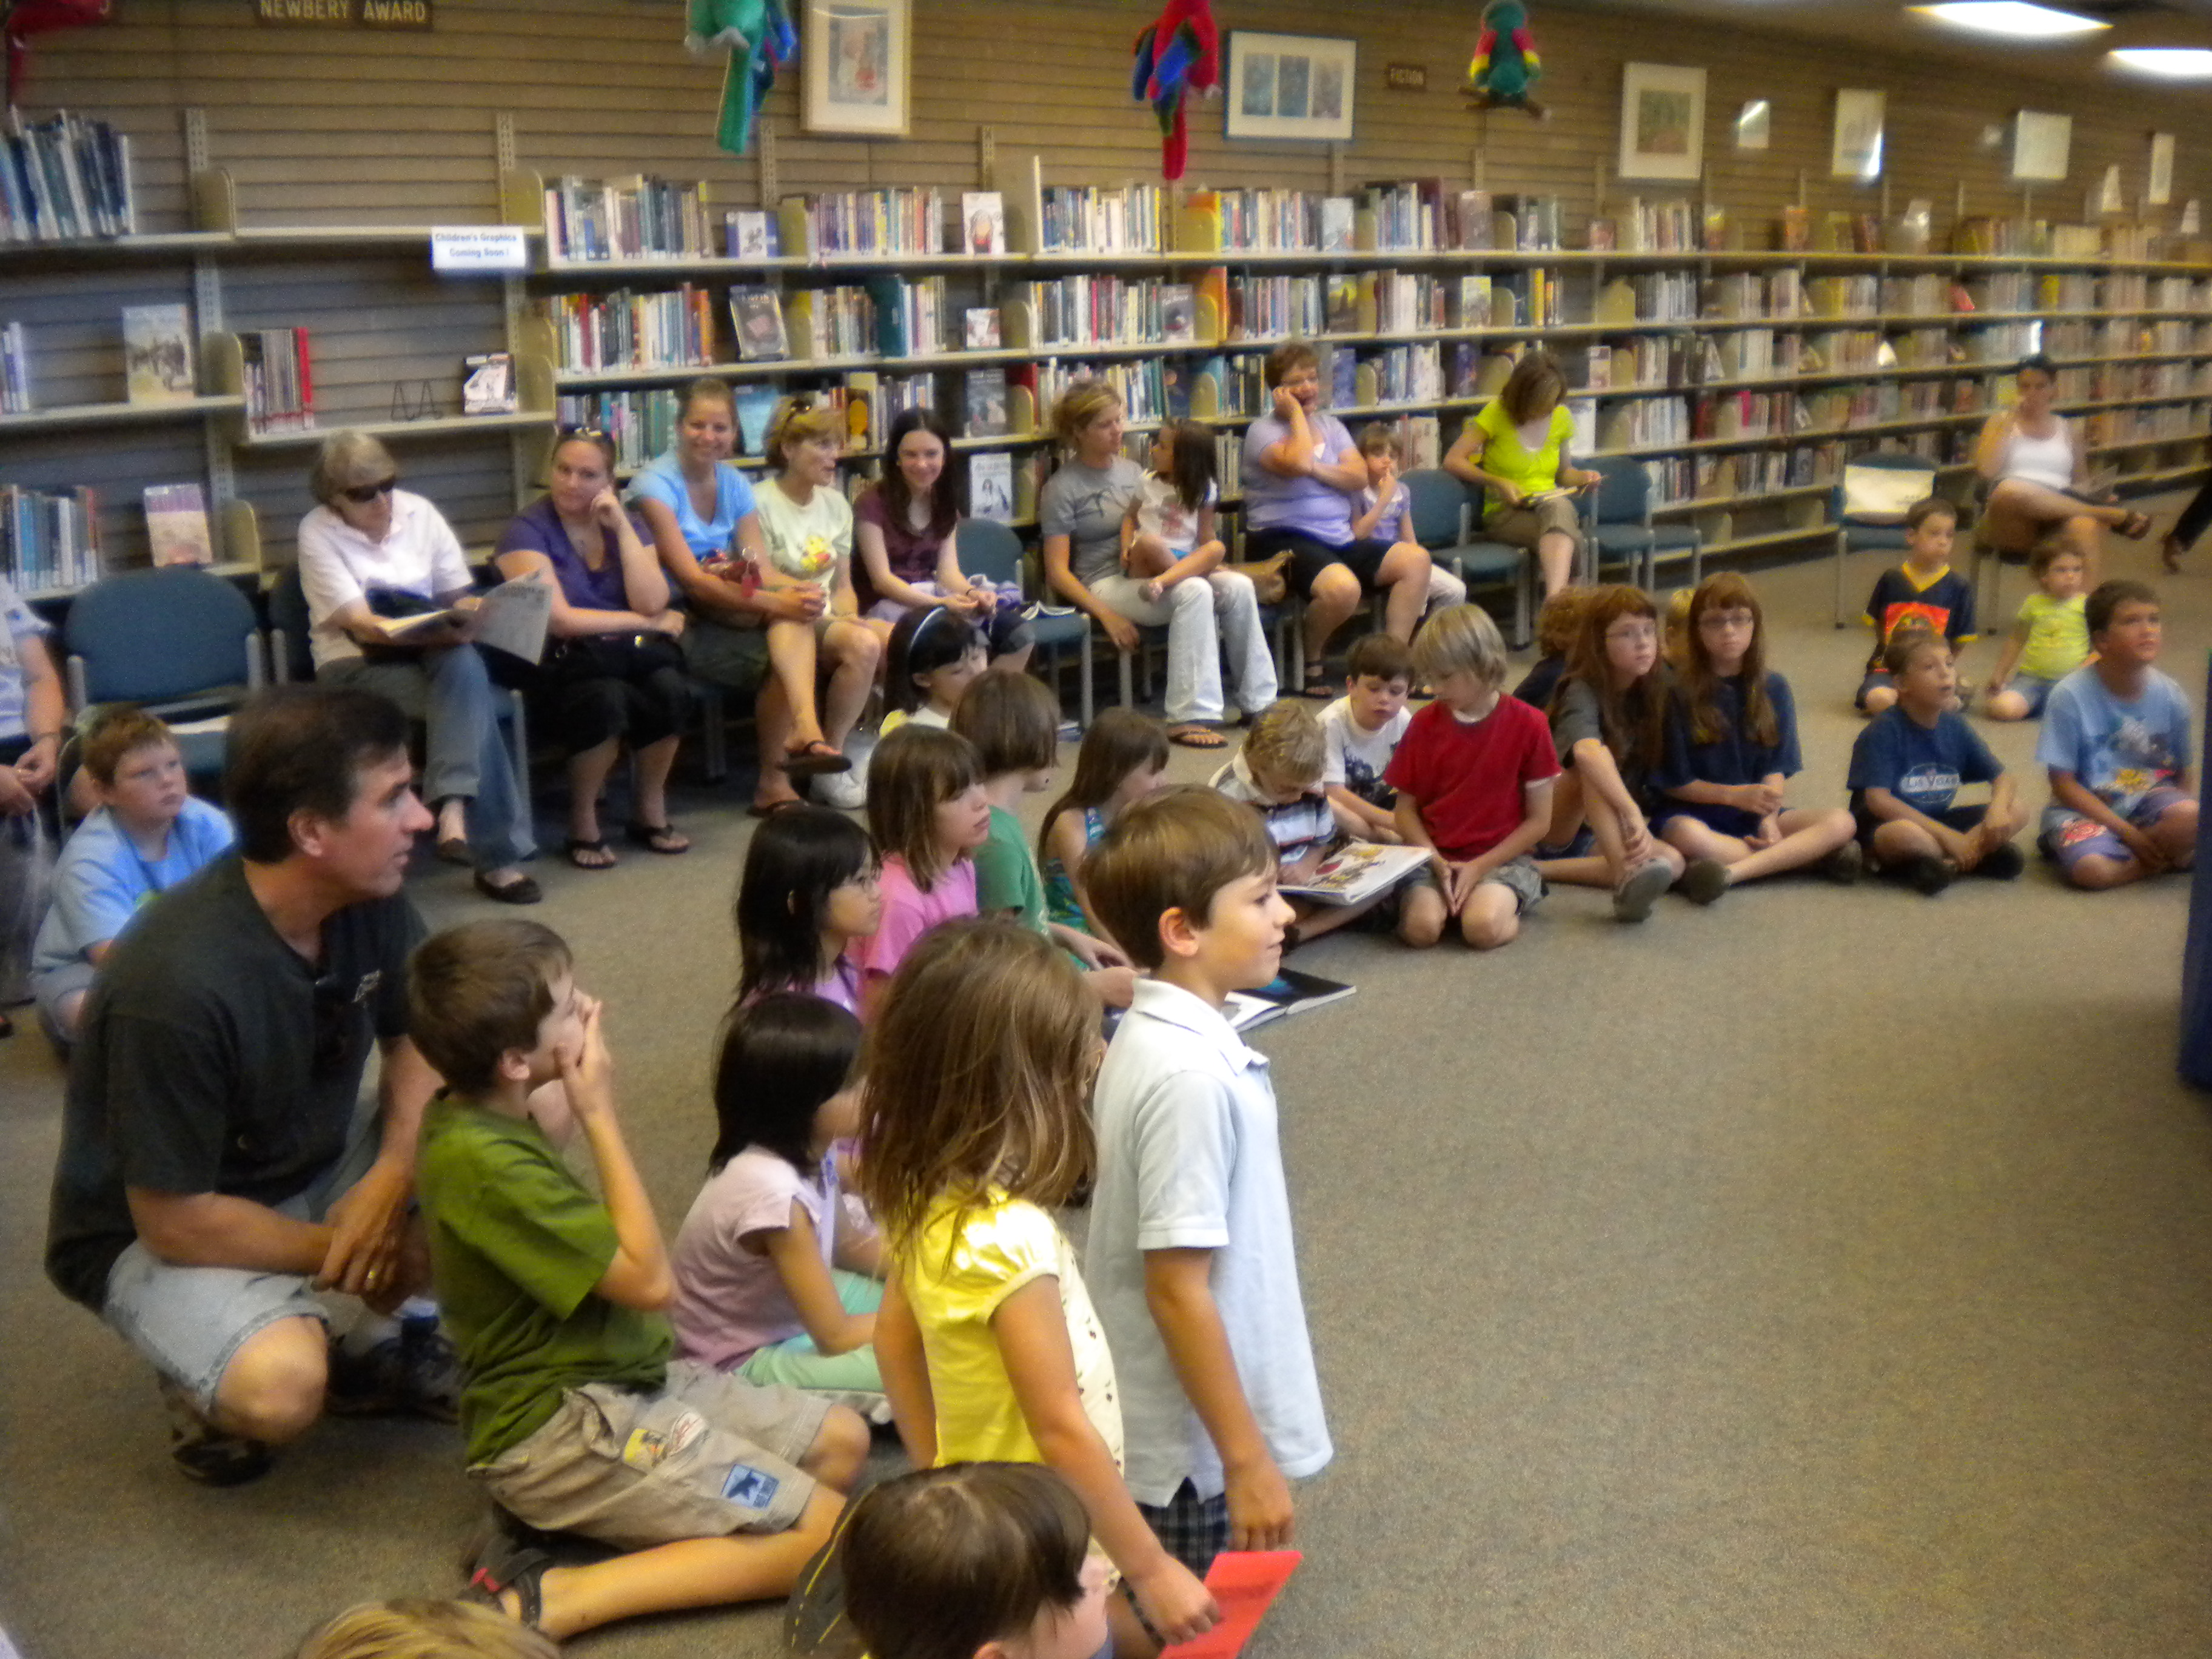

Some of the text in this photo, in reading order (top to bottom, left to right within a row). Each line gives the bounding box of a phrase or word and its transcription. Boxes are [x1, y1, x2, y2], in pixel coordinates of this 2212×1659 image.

[260, 0, 427, 23] NEWBERY AWARD
[435, 232, 517, 244] Children's Graphics
[449, 248, 481, 259] Coming
